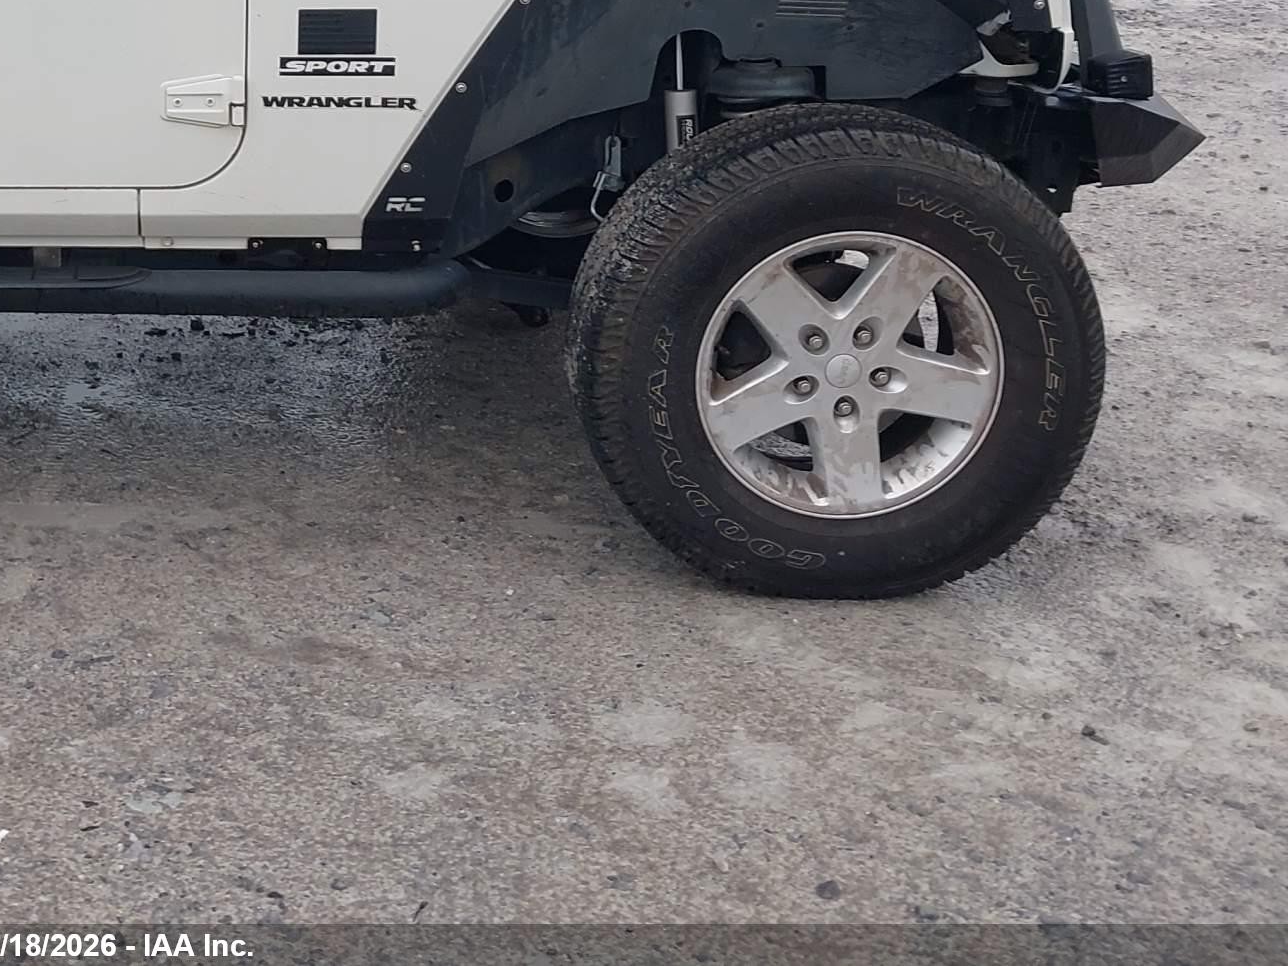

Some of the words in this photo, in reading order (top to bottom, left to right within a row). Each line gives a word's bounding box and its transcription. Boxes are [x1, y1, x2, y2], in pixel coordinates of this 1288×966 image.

[280, 60, 396, 73] SPORT
[261, 95, 423, 111] WRANGLER
[385, 196, 426, 212] RC
[896, 185, 1067, 432] WRANGLER
[648, 323, 827, 570] GOODYEAR
